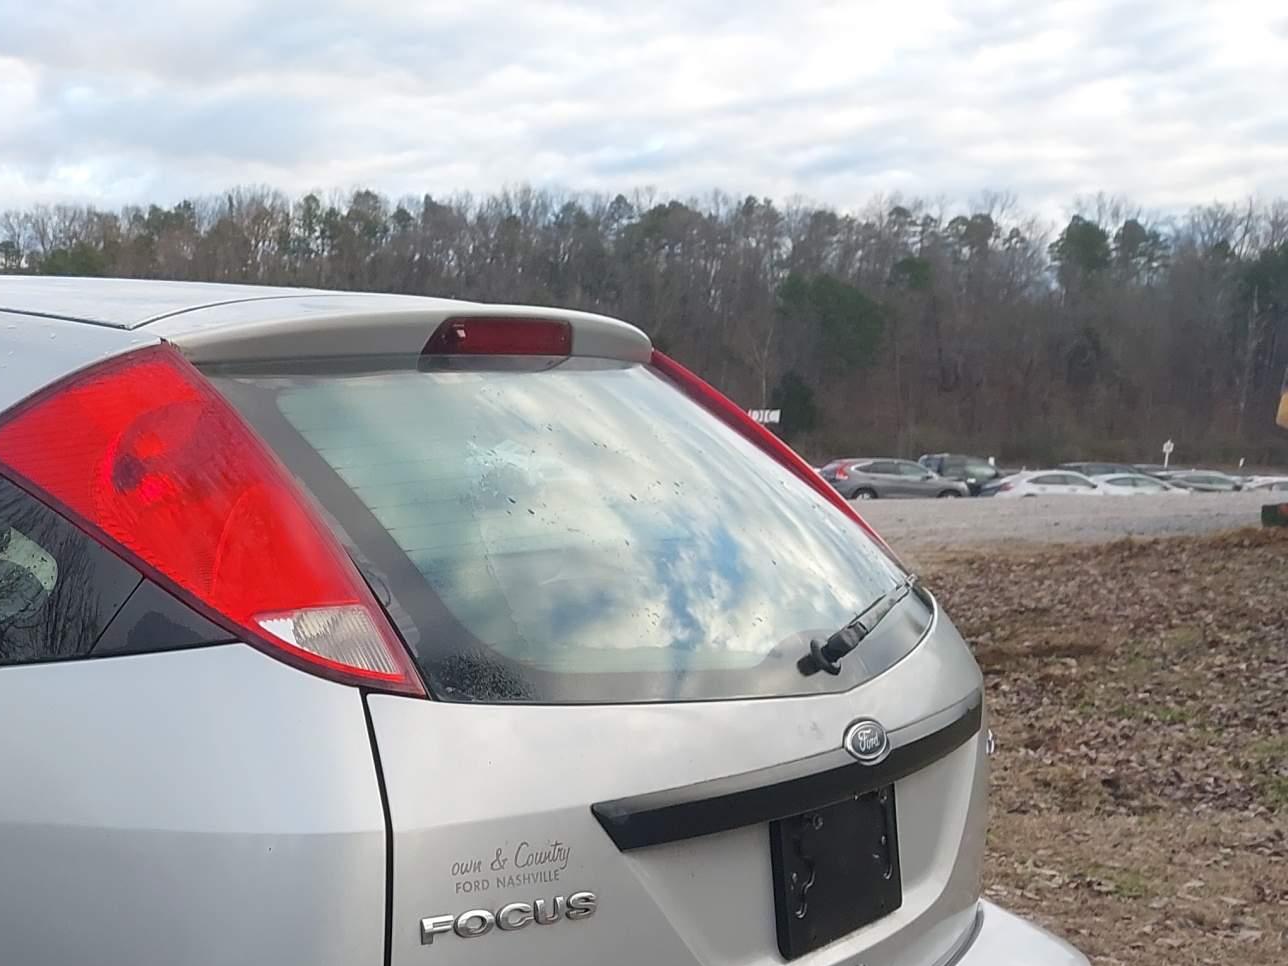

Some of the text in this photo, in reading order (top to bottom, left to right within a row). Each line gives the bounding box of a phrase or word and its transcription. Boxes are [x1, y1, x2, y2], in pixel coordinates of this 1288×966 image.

[857, 728, 880, 752] Ford
[490, 848, 508, 871] &
[514, 840, 571, 870] Country
[455, 869, 560, 894] FORD NASHVILLE
[420, 891, 597, 945] FOCUS
